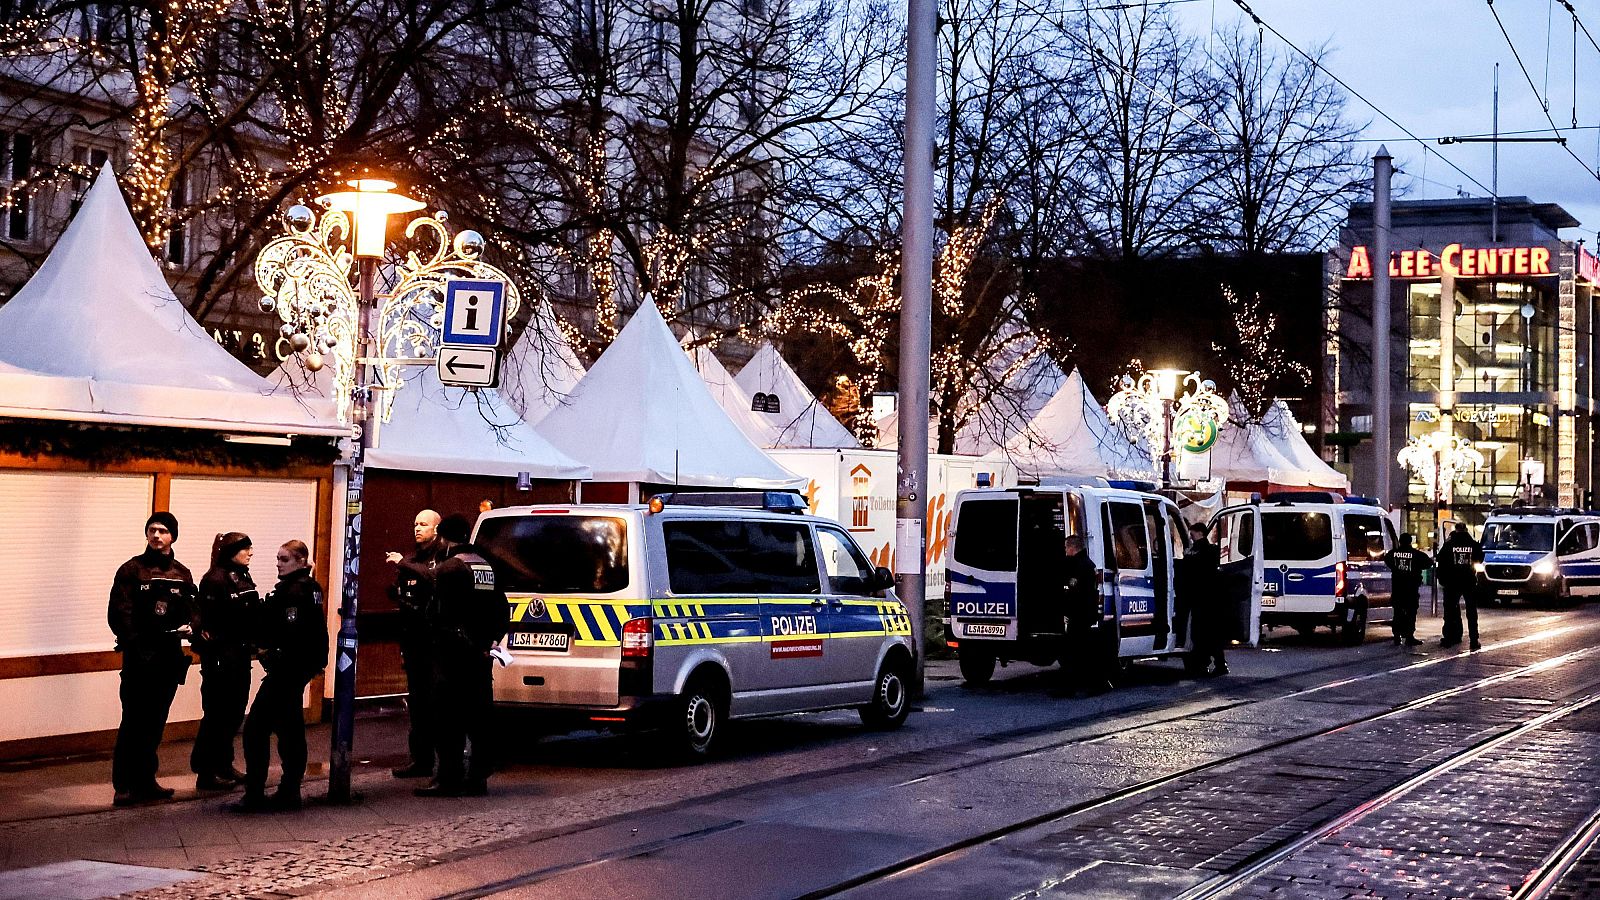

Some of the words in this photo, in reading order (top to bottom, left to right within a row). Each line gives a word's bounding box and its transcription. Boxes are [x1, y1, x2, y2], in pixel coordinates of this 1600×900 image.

[1347, 244, 1550, 277] ALEE-CENTER
[474, 570, 494, 584] POLIZEI
[1263, 583, 1278, 591] ZEI
[957, 602, 1009, 614] POLIZEI
[1129, 600, 1147, 613] POLIZEI
[771, 616, 817, 635] POLIZEI
[514, 634, 531, 645] LSA
[538, 635, 566, 646] 47860
